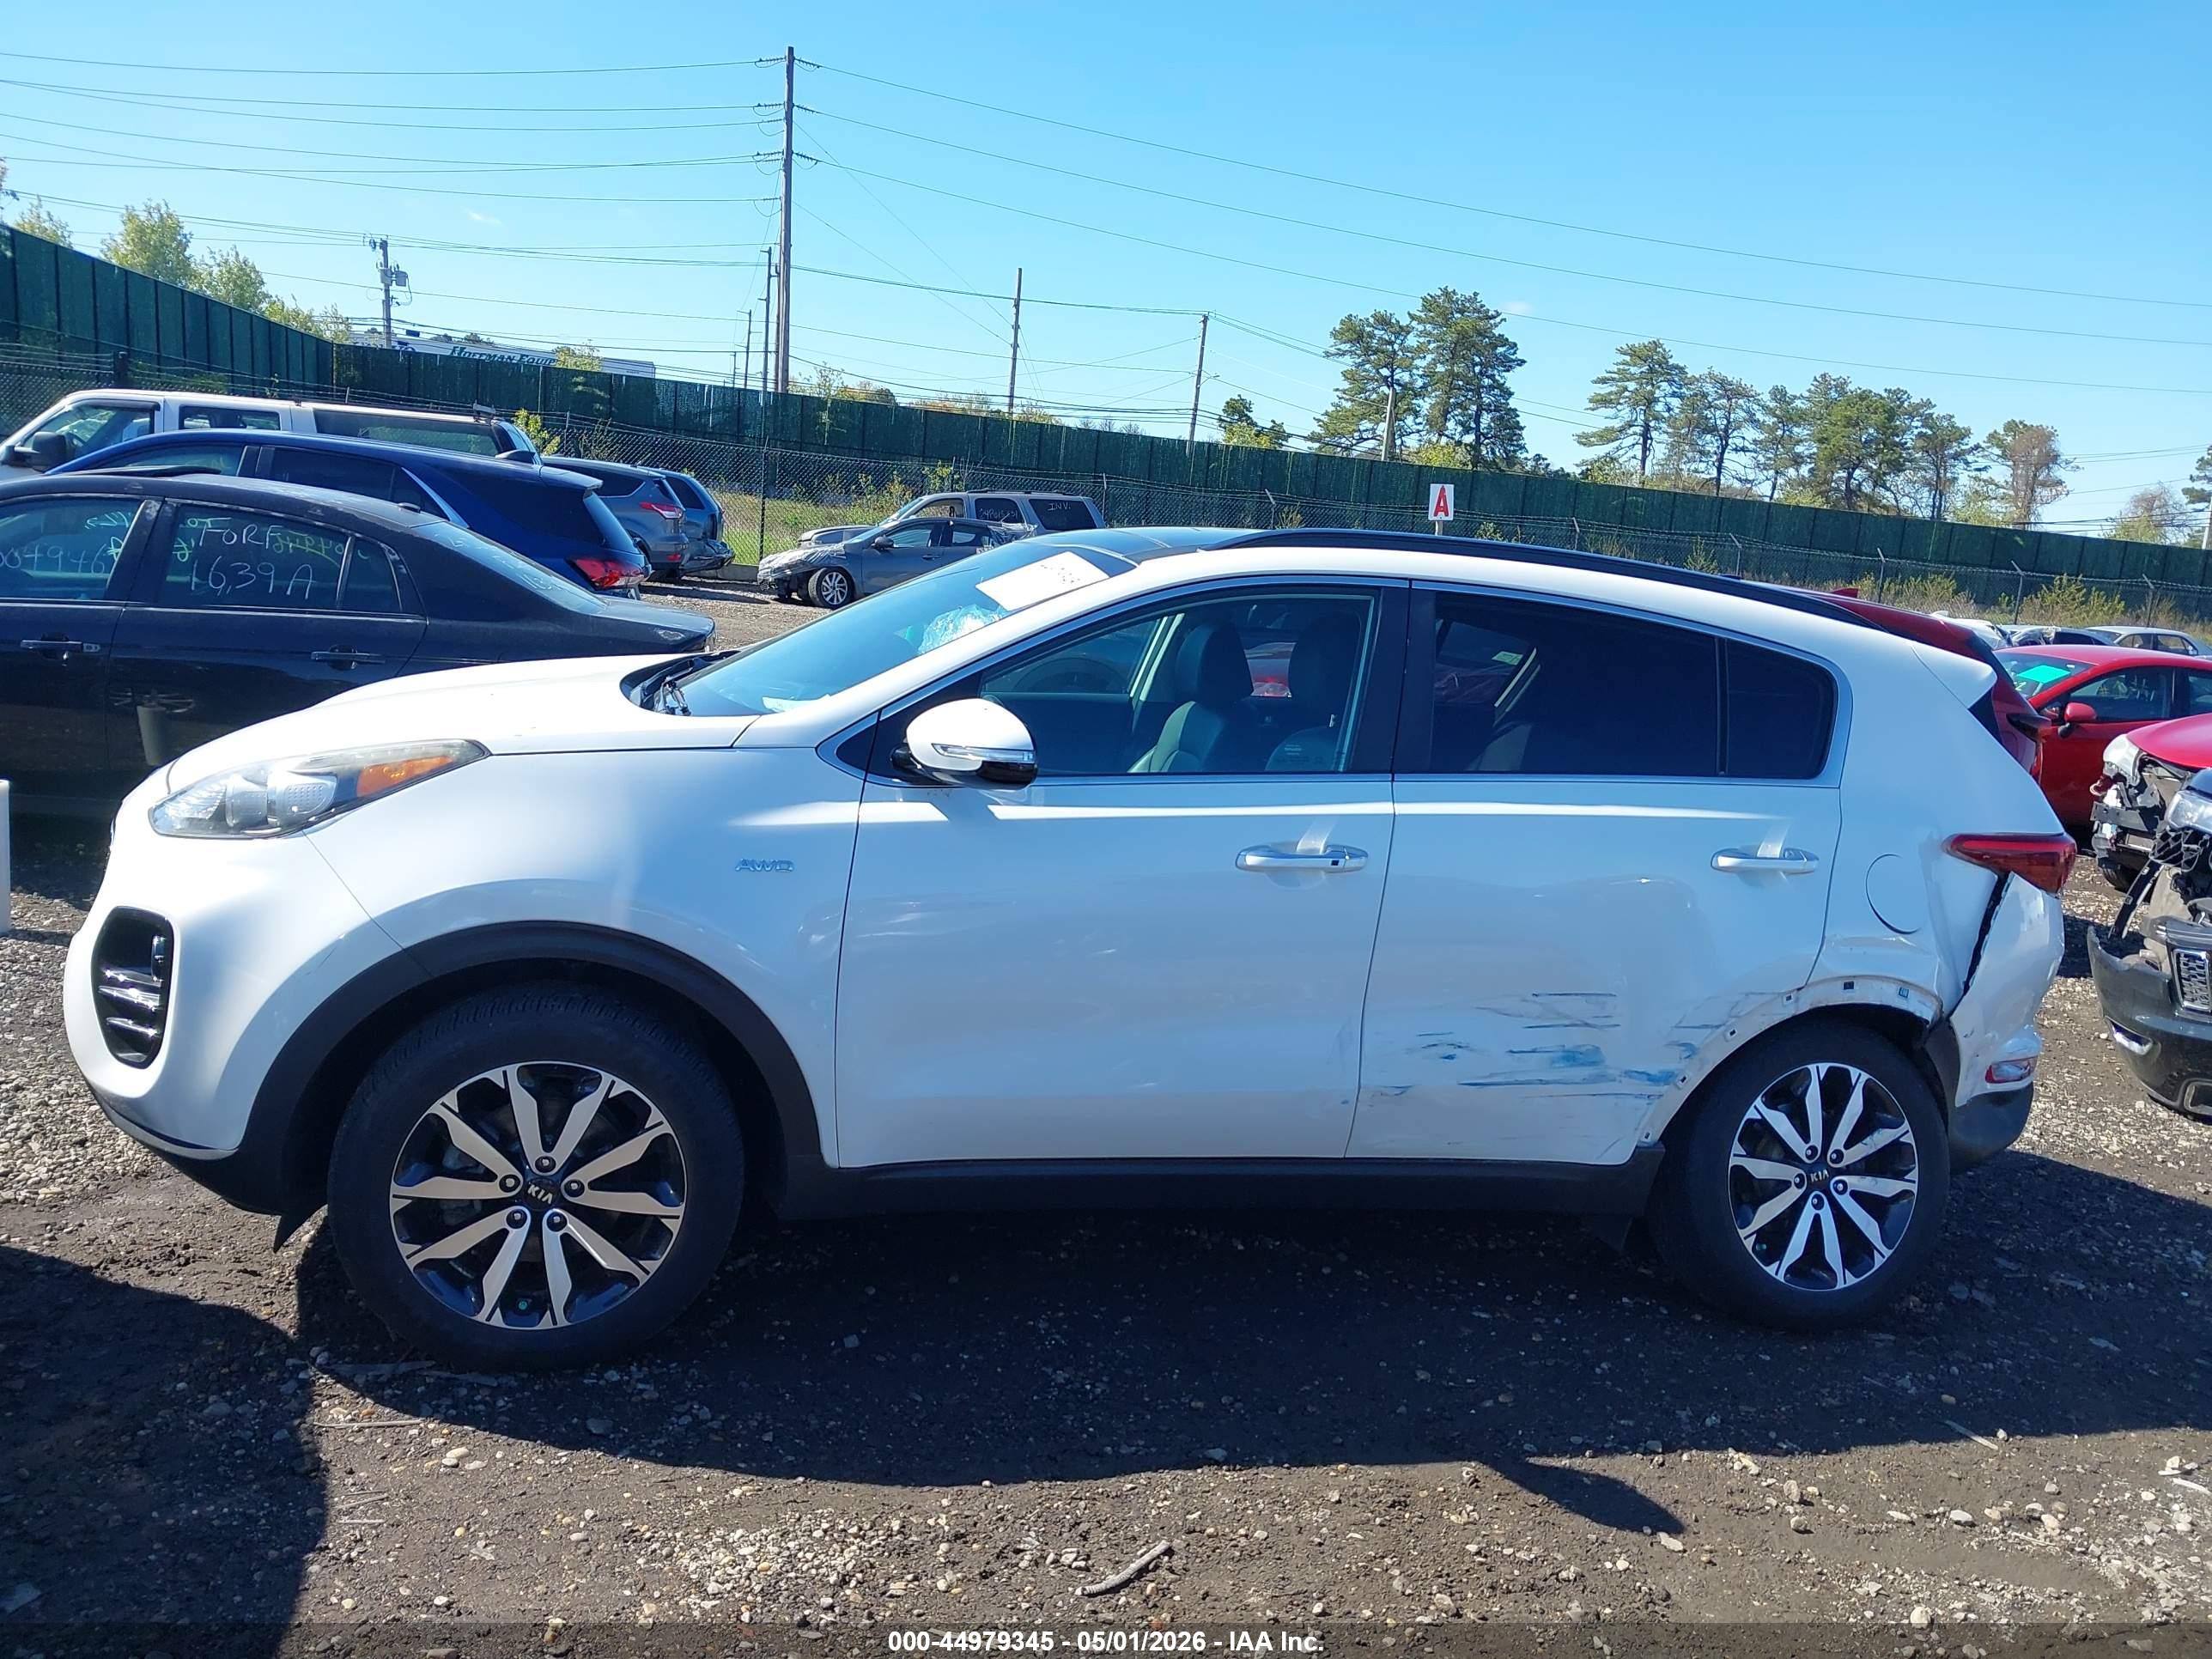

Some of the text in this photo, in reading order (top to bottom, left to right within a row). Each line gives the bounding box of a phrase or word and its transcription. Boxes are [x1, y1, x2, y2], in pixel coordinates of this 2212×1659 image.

[1433, 484, 1449, 517] A
[735, 858, 794, 872] AWD
[1810, 1168, 1829, 1182] KIA
[527, 1184, 553, 1205] KIA
